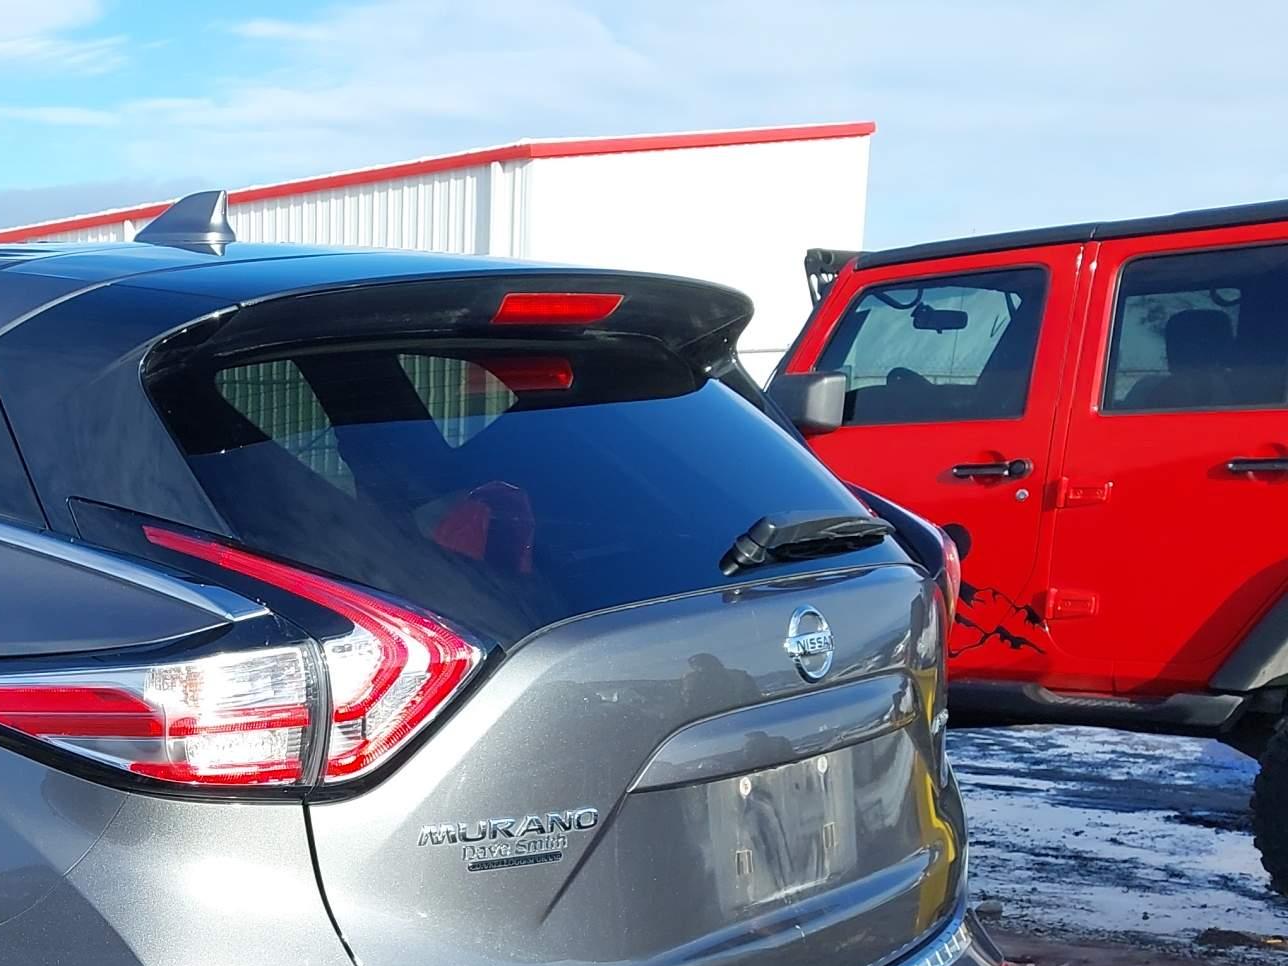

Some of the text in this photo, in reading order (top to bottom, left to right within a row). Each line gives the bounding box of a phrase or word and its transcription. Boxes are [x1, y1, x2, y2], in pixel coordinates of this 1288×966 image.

[417, 807, 599, 846] MURANO
[463, 842, 511, 861] Dave
[515, 833, 568, 855] Smith
